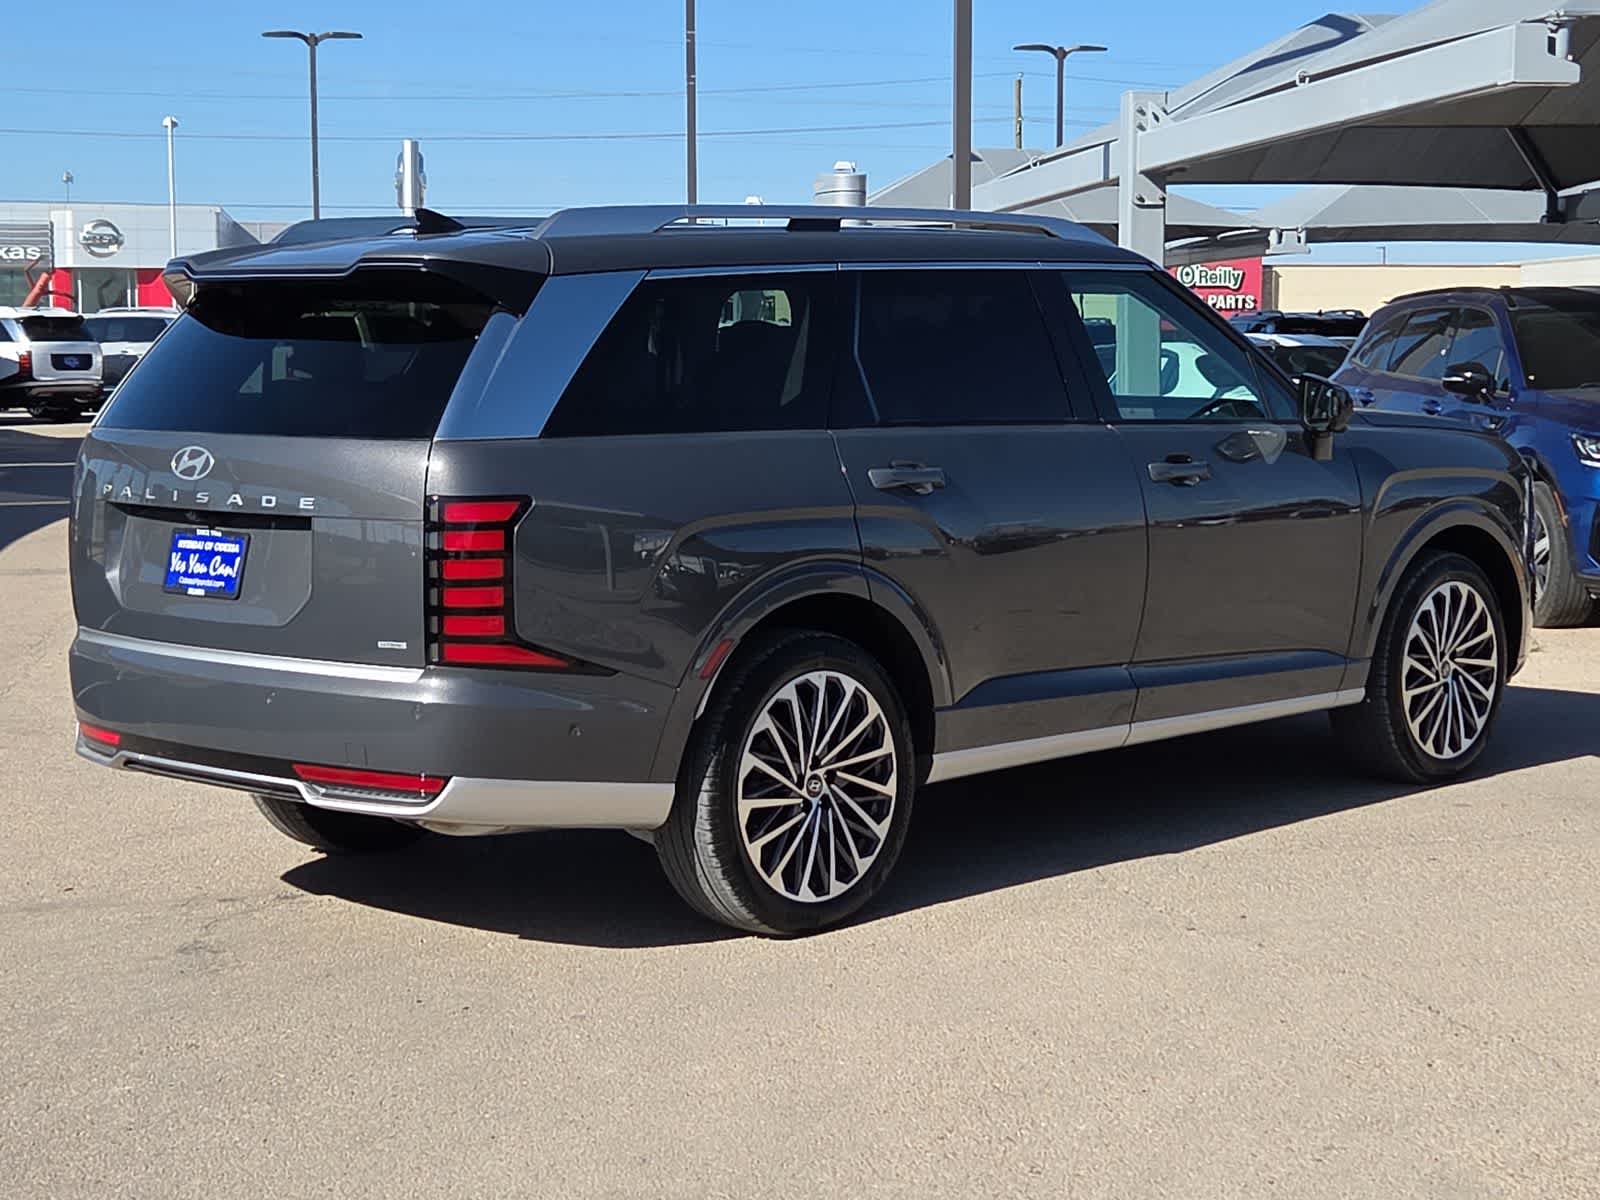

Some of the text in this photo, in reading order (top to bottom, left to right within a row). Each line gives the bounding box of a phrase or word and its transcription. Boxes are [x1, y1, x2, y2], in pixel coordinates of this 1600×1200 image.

[1179, 265, 1241, 287] O'Reilly
[1207, 295, 1255, 309] PARTS
[103, 484, 315, 509] PALISADE
[170, 551, 241, 578] Yes You Can!
